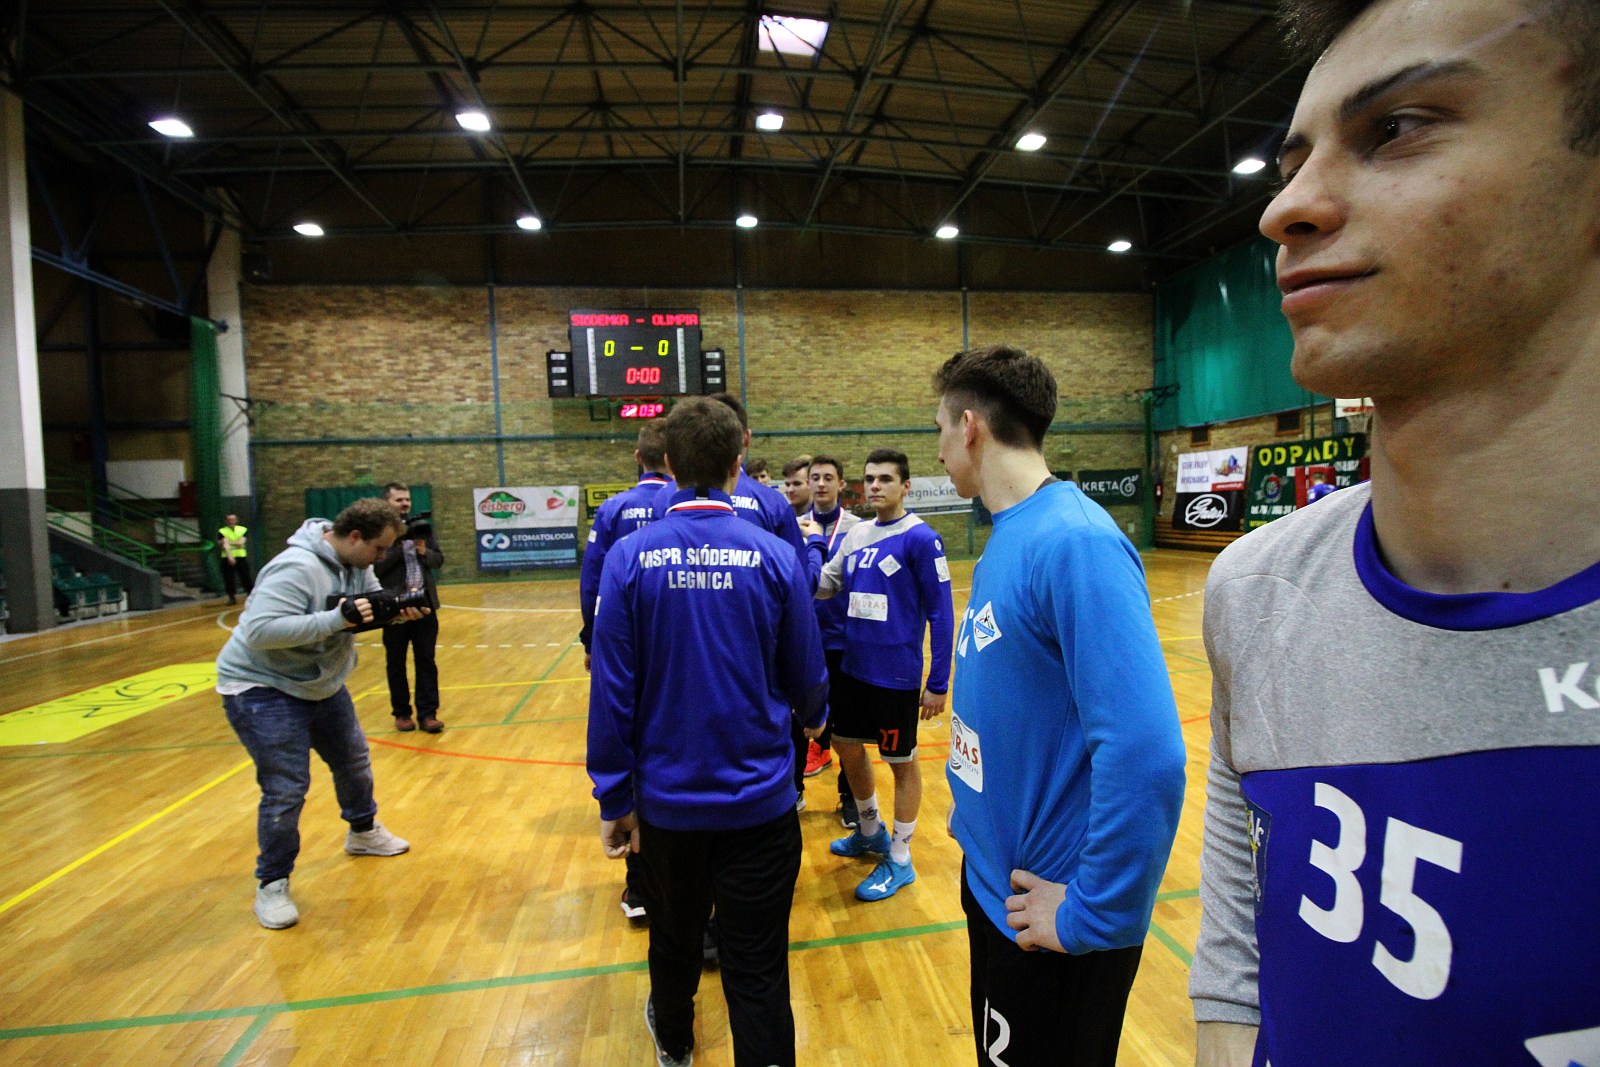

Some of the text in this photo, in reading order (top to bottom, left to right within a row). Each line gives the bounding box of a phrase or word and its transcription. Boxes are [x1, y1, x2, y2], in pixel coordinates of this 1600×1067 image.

[652, 314, 698, 326] OLIMPIA
[604, 340, 615, 356] 0
[658, 340, 669, 356] 0
[626, 367, 661, 384] 0:00
[1258, 437, 1355, 466] ODPADY
[904, 486, 956, 501] egnickie
[1082, 480, 1119, 493] KRĘTA
[512, 532, 575, 542] STOMATOLOGIA
[639, 544, 762, 569] MSPR SIÓDEMKA
[858, 547, 879, 568] 27
[668, 571, 734, 589] LEGNICA
[879, 729, 899, 751] 27
[1299, 782, 1463, 1000] 35
